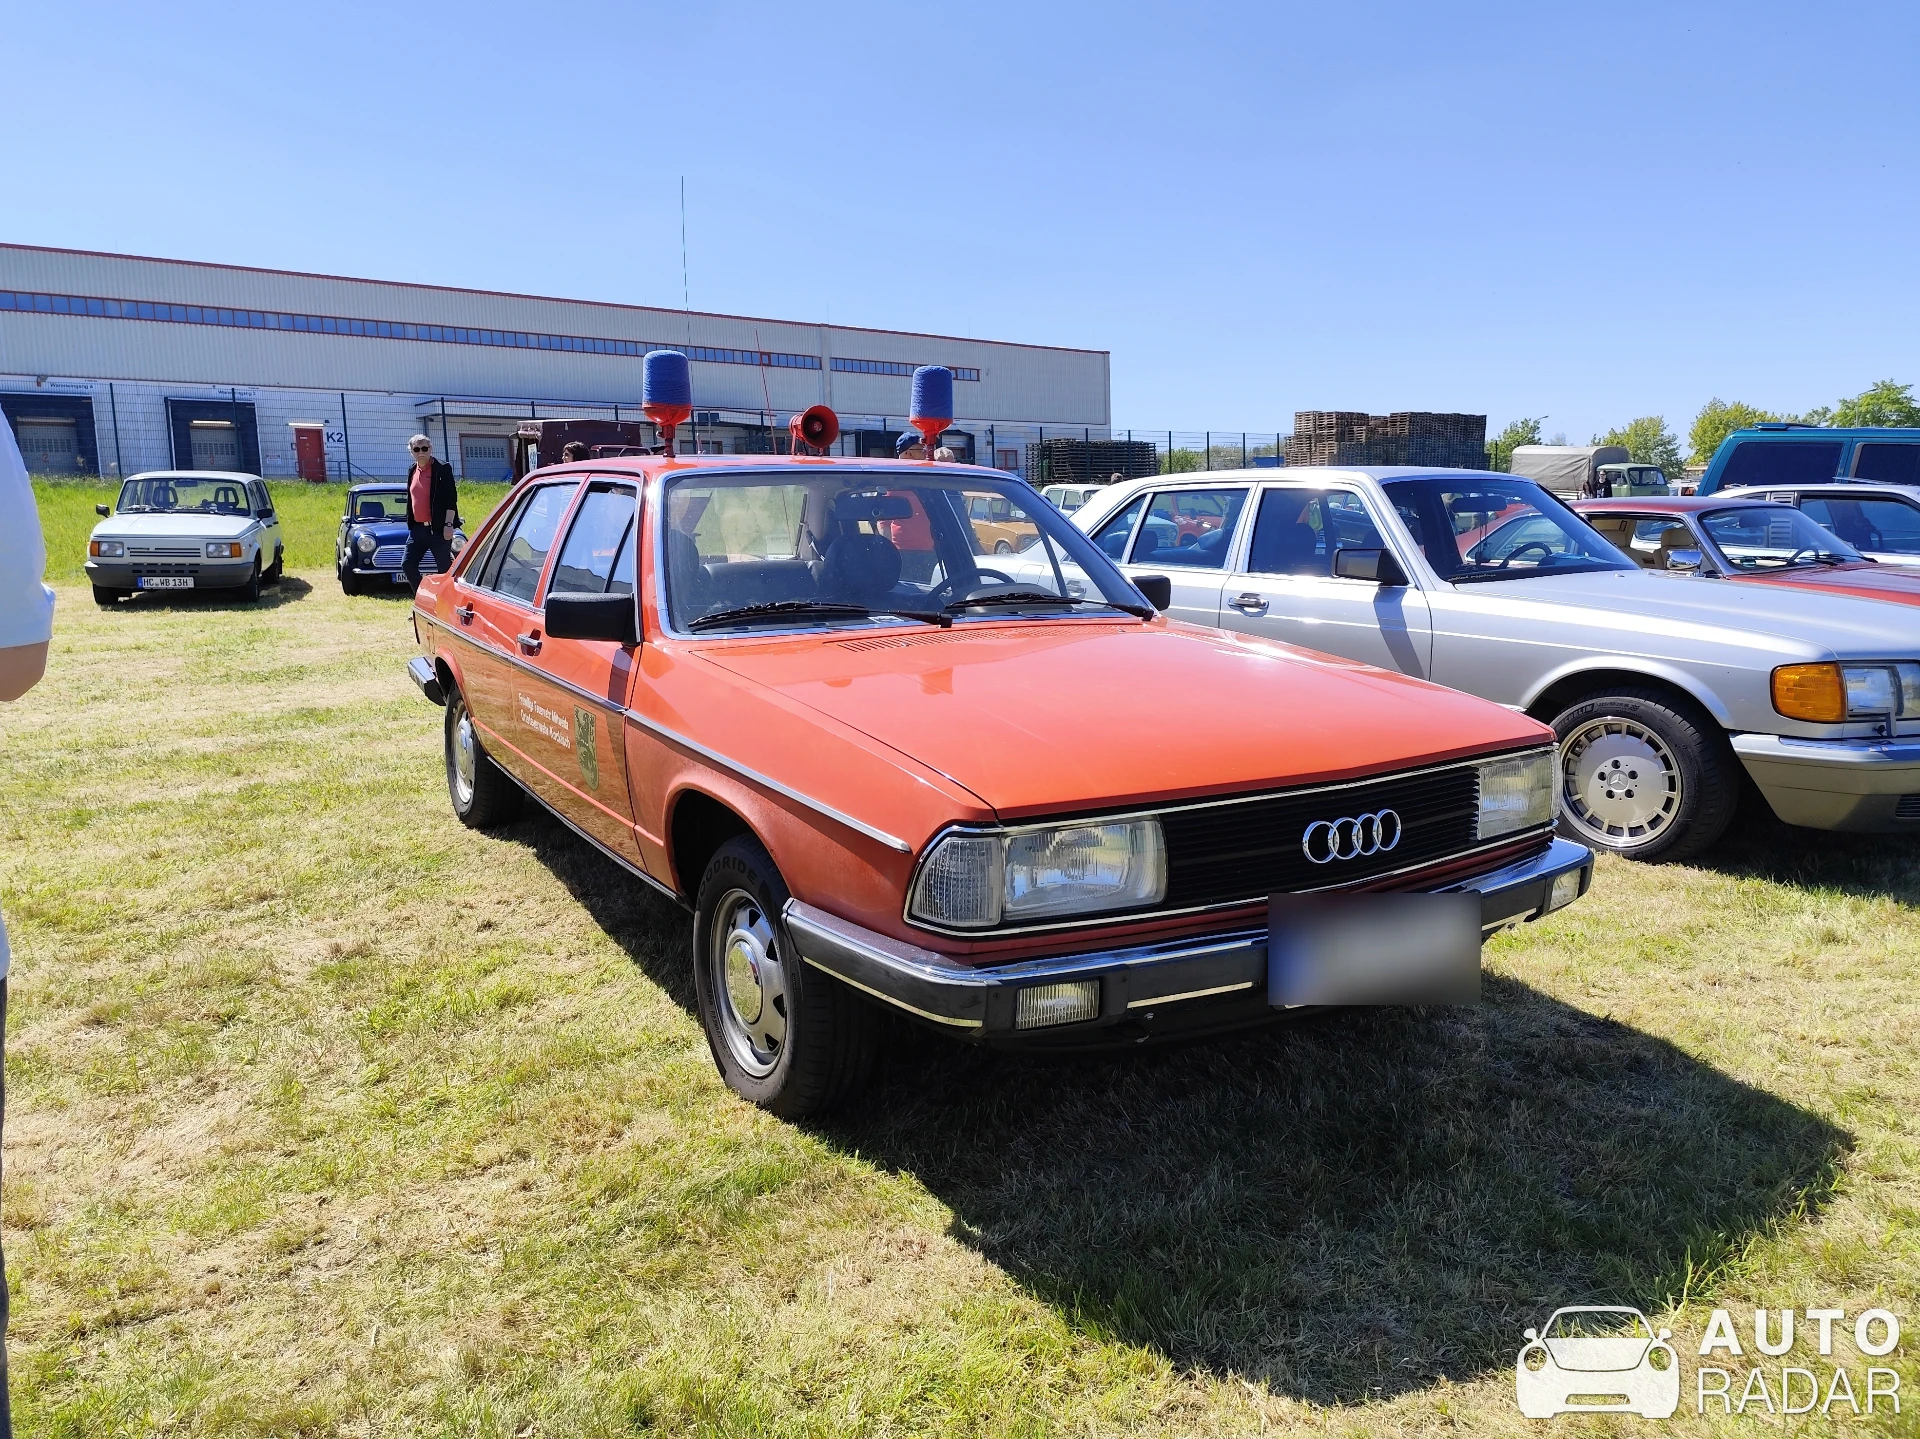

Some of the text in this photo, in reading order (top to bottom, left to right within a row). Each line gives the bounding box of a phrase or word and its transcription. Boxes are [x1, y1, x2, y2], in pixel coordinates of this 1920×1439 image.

[326, 432, 344, 443] K2
[143, 578, 188, 587] HC WB 13H
